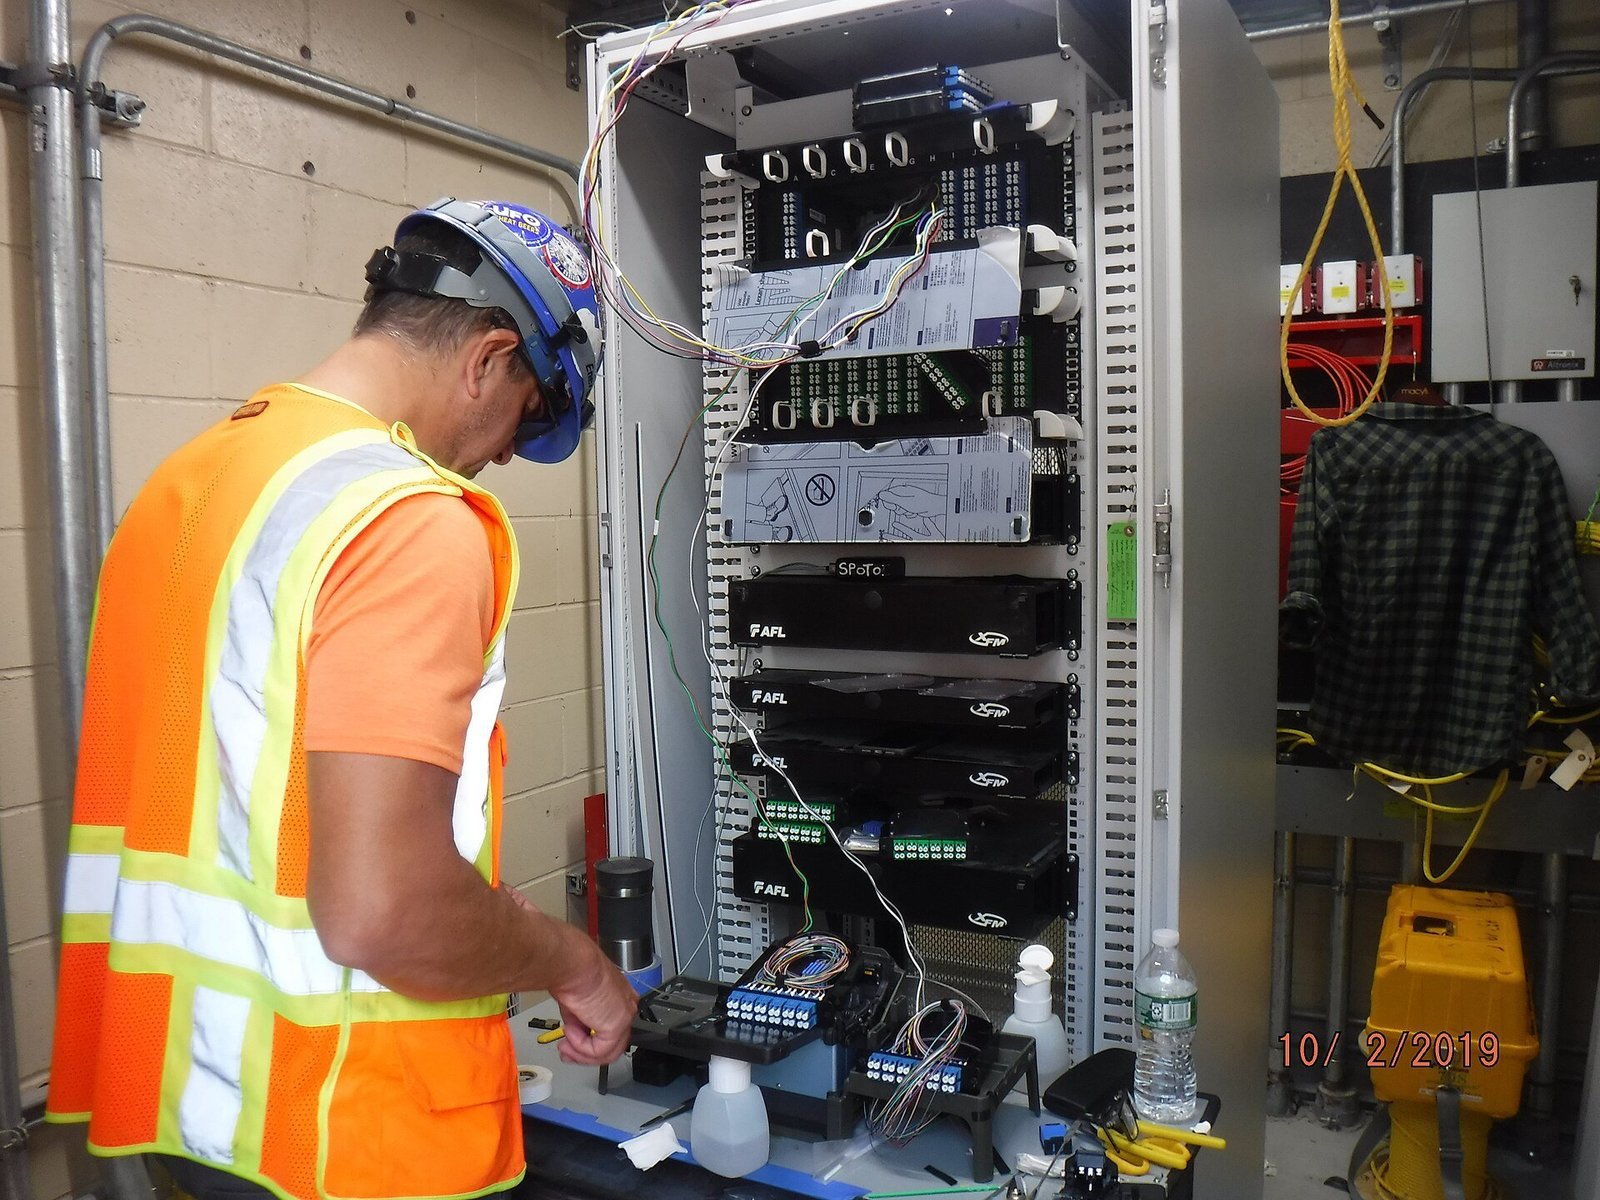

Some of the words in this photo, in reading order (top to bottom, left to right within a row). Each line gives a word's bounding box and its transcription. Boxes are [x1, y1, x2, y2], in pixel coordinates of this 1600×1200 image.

[869, 163, 875, 171] E
[908, 157, 916, 165] G
[929, 154, 936, 162] H
[493, 203, 541, 227] UFO
[498, 215, 517, 226] HEAT
[760, 625, 786, 638] AFL
[974, 631, 1008, 647] XFM
[762, 691, 788, 705] AFL
[975, 702, 1008, 718] XFM
[974, 772, 1007, 787] XFM
[763, 884, 789, 898] AFL
[973, 912, 1006, 928] XFM
